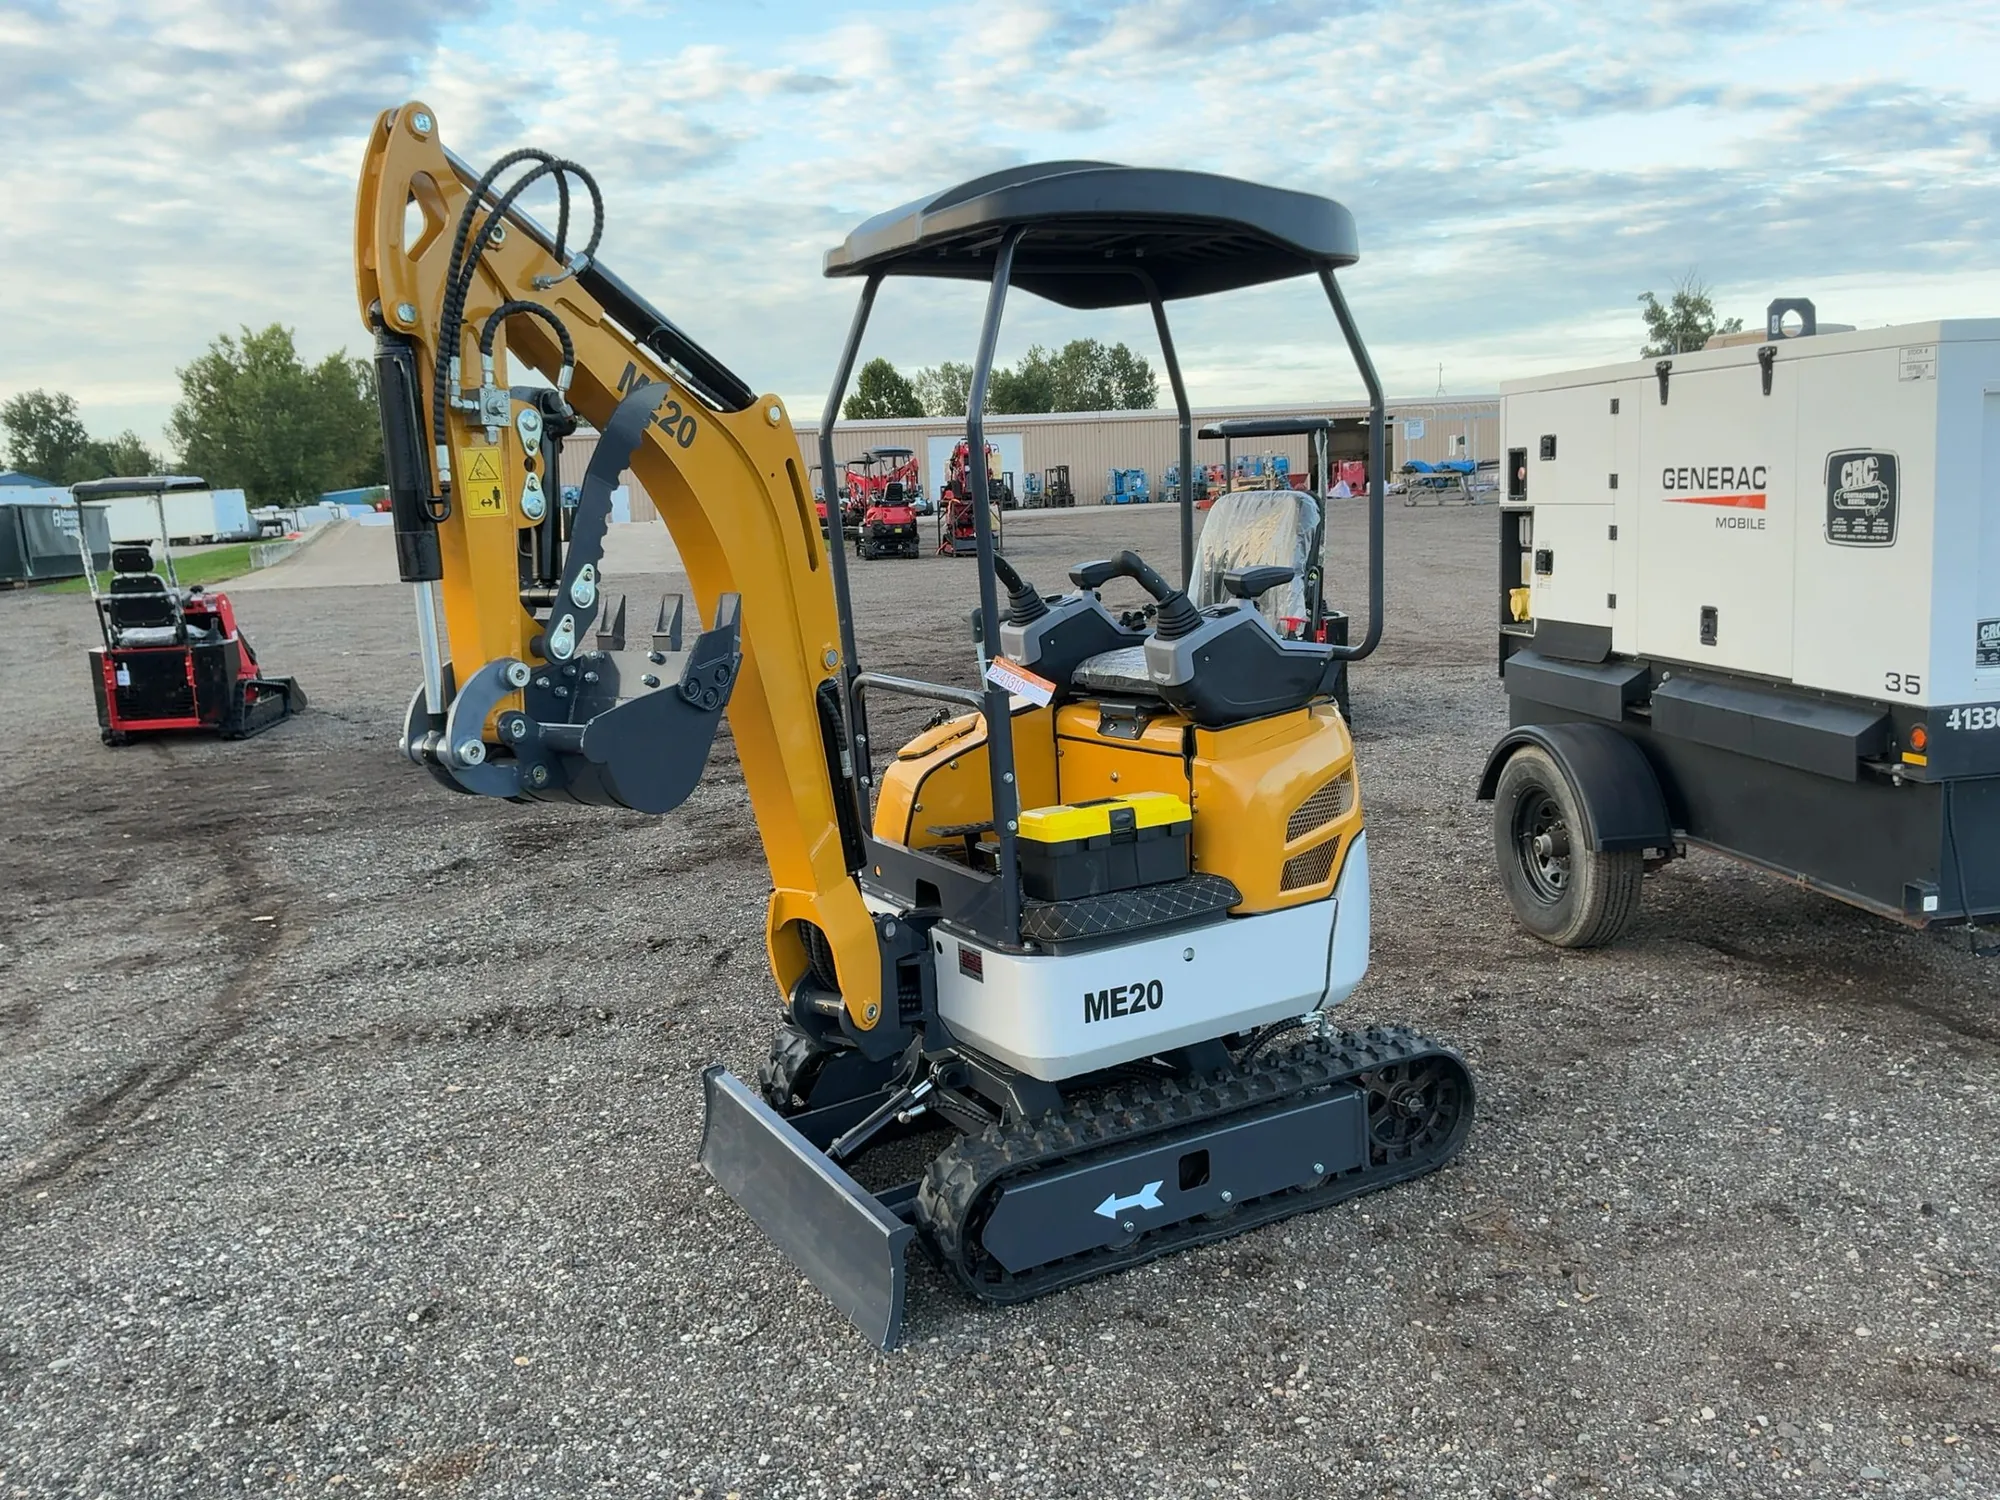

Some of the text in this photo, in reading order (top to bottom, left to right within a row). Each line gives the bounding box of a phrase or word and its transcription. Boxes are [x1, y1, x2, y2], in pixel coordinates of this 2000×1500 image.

[1662, 465, 1767, 490] GENERAC
[1840, 456, 1879, 490] CRC
[1715, 517, 1766, 530] MOBILE
[1980, 622, 2000, 641] CR
[1885, 672, 1921, 695] 35
[1084, 979, 1164, 1024] ME20
